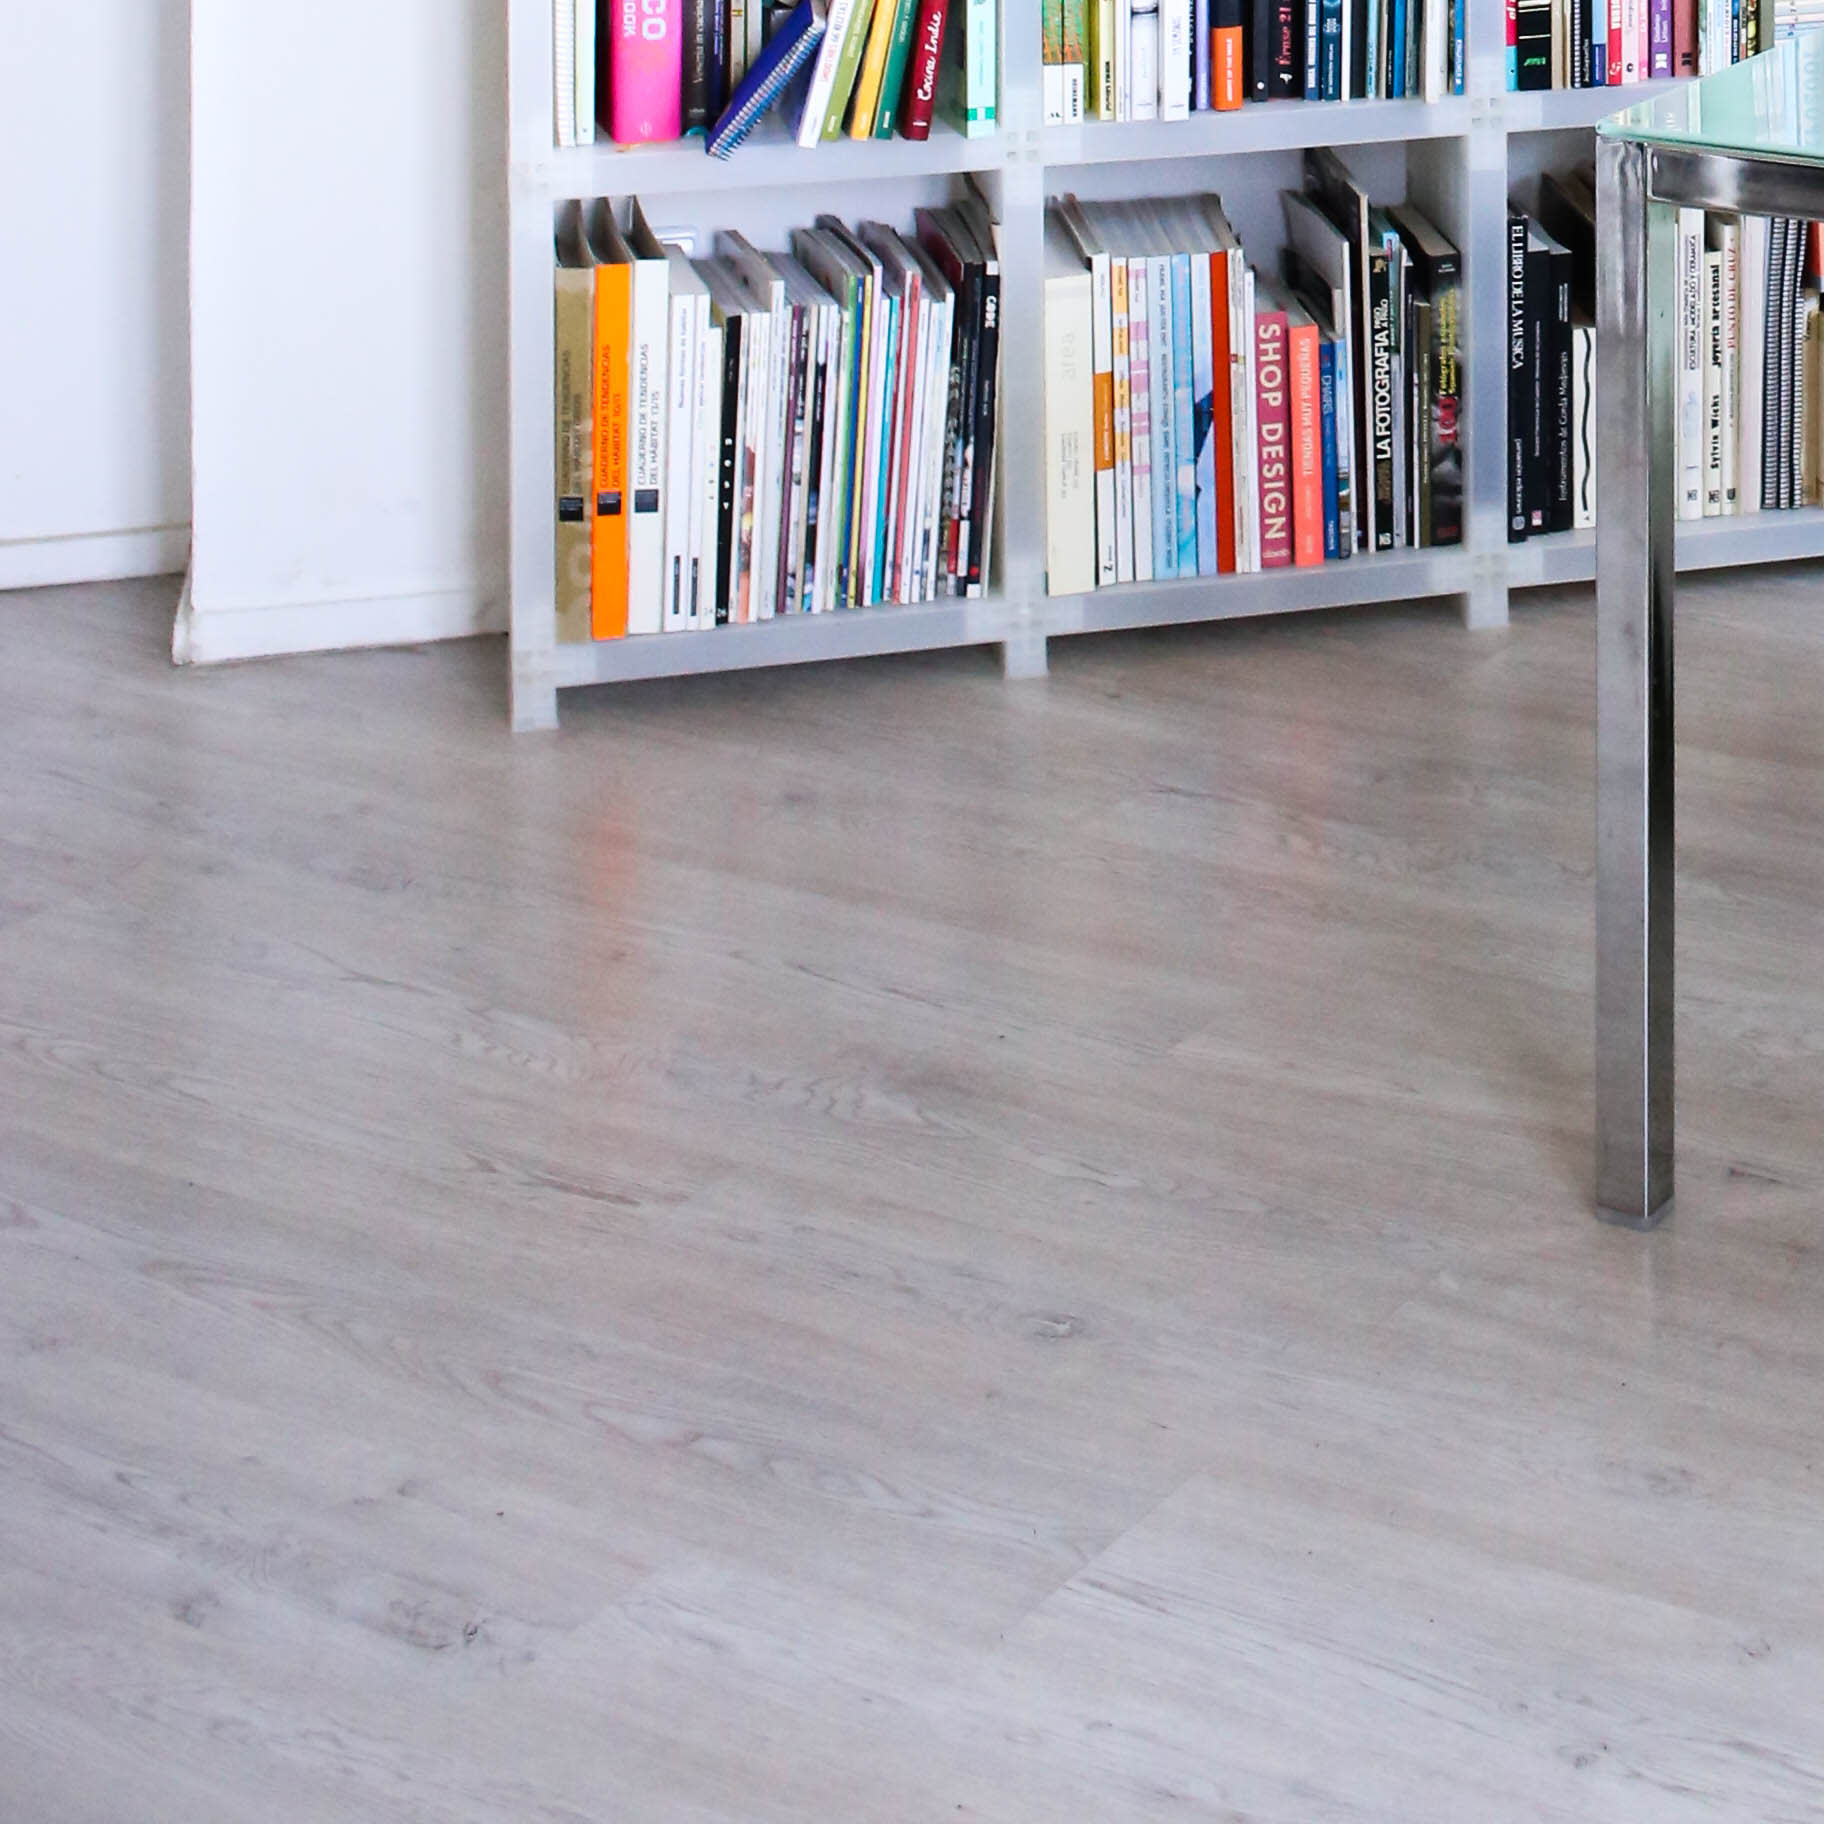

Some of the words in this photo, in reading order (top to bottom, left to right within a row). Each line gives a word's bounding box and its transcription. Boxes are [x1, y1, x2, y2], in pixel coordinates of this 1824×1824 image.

[922, 11, 942, 53] Indie
[1278, 8, 1293, 23] 21
[1506, 6, 1518, 21] el
[1276, 26, 1293, 65] Érase
[915, 57, 937, 102] Cocina
[1511, 224, 1524, 241] EL
[1511, 242, 1524, 280] LIBRO
[1726, 246, 1737, 282] CRUZ
[1511, 281, 1524, 299] DE
[1511, 300, 1524, 318] LA
[1709, 263, 1721, 321] artesanal
[1727, 286, 1738, 303] DE
[983, 295, 998, 329] CODE
[1727, 304, 1738, 350] PUNTO
[1511, 319, 1525, 369] MUSICA
[1709, 324, 1722, 368] joyería
[599, 344, 611, 409] TENDENCIAS
[637, 342, 649, 409] TENDENCIAS
[1257, 323, 1284, 407] SHOP
[1299, 338, 1314, 399] PEQUEÑAS
[1373, 330, 1391, 437] FOTOGRAFIA
[599, 411, 611, 427] DE
[637, 410, 649, 425] DE
[1301, 402, 1314, 427] MUY
[1437, 397, 1458, 444] 100
[1709, 394, 1720, 429] Wicks
[599, 429, 611, 488] CUADERNO
[637, 427, 649, 486] CUADERNO
[1302, 428, 1315, 477] TIENDAS
[1376, 438, 1392, 460] LA
[1709, 434, 1720, 470] Sylvia
[610, 467, 622, 488] DEL
[648, 466, 660, 485] DEL
[1260, 422, 1288, 540] DESIGN
